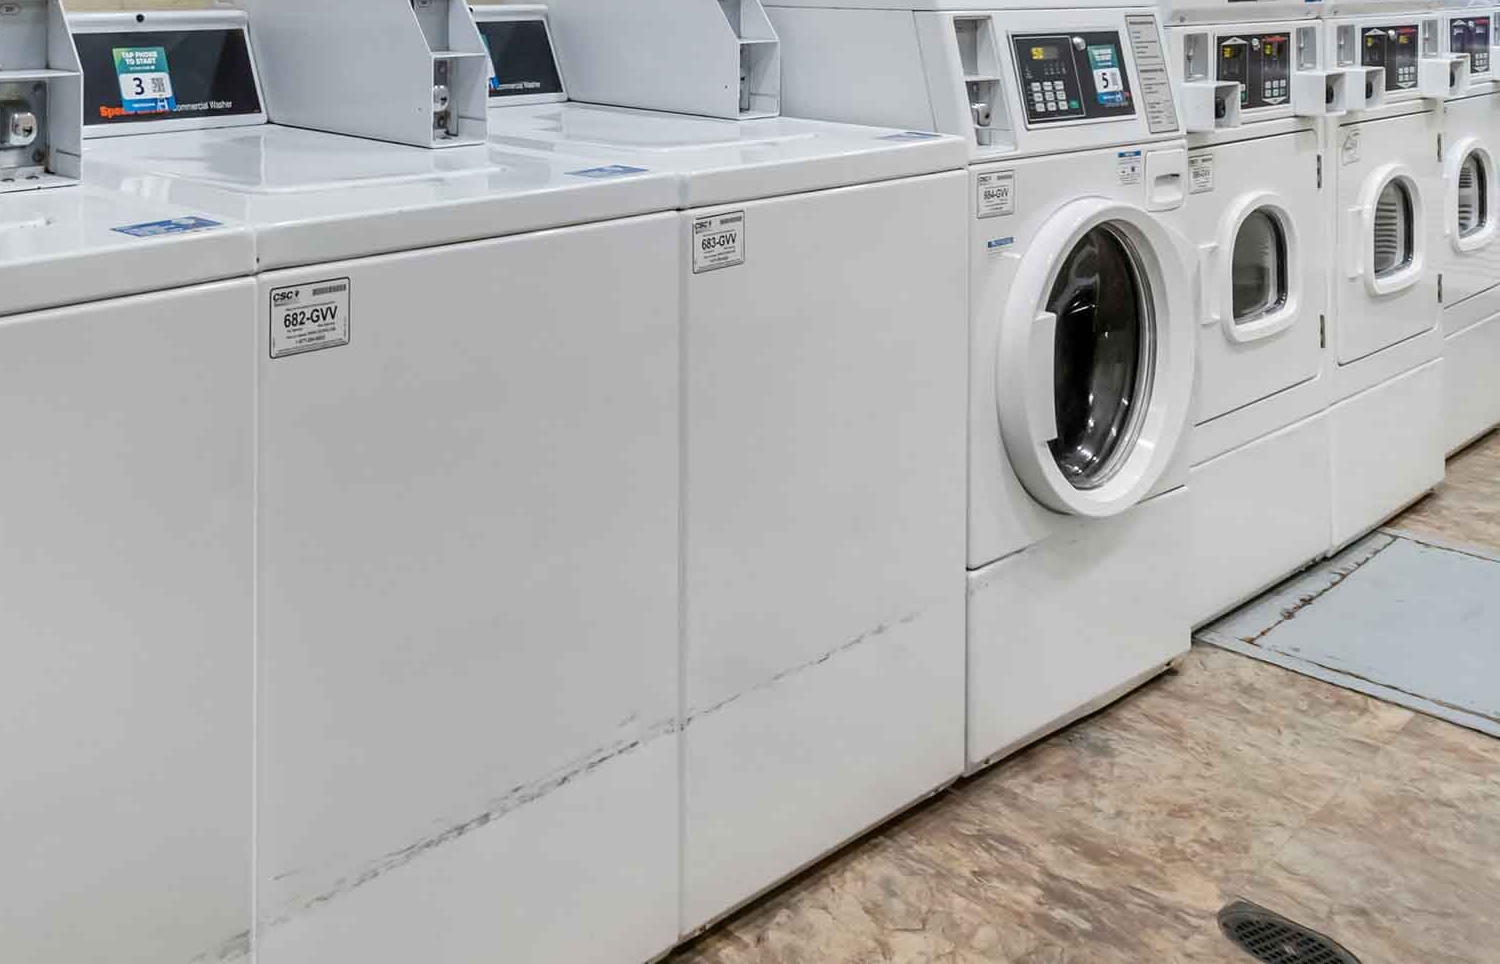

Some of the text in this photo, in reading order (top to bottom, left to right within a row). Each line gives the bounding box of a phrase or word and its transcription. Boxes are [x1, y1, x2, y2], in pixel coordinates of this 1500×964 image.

[133, 77, 145, 96] 3
[1101, 72, 1109, 89] 5
[273, 290, 293, 301] CSC
[284, 305, 338, 328] 682-GVV
